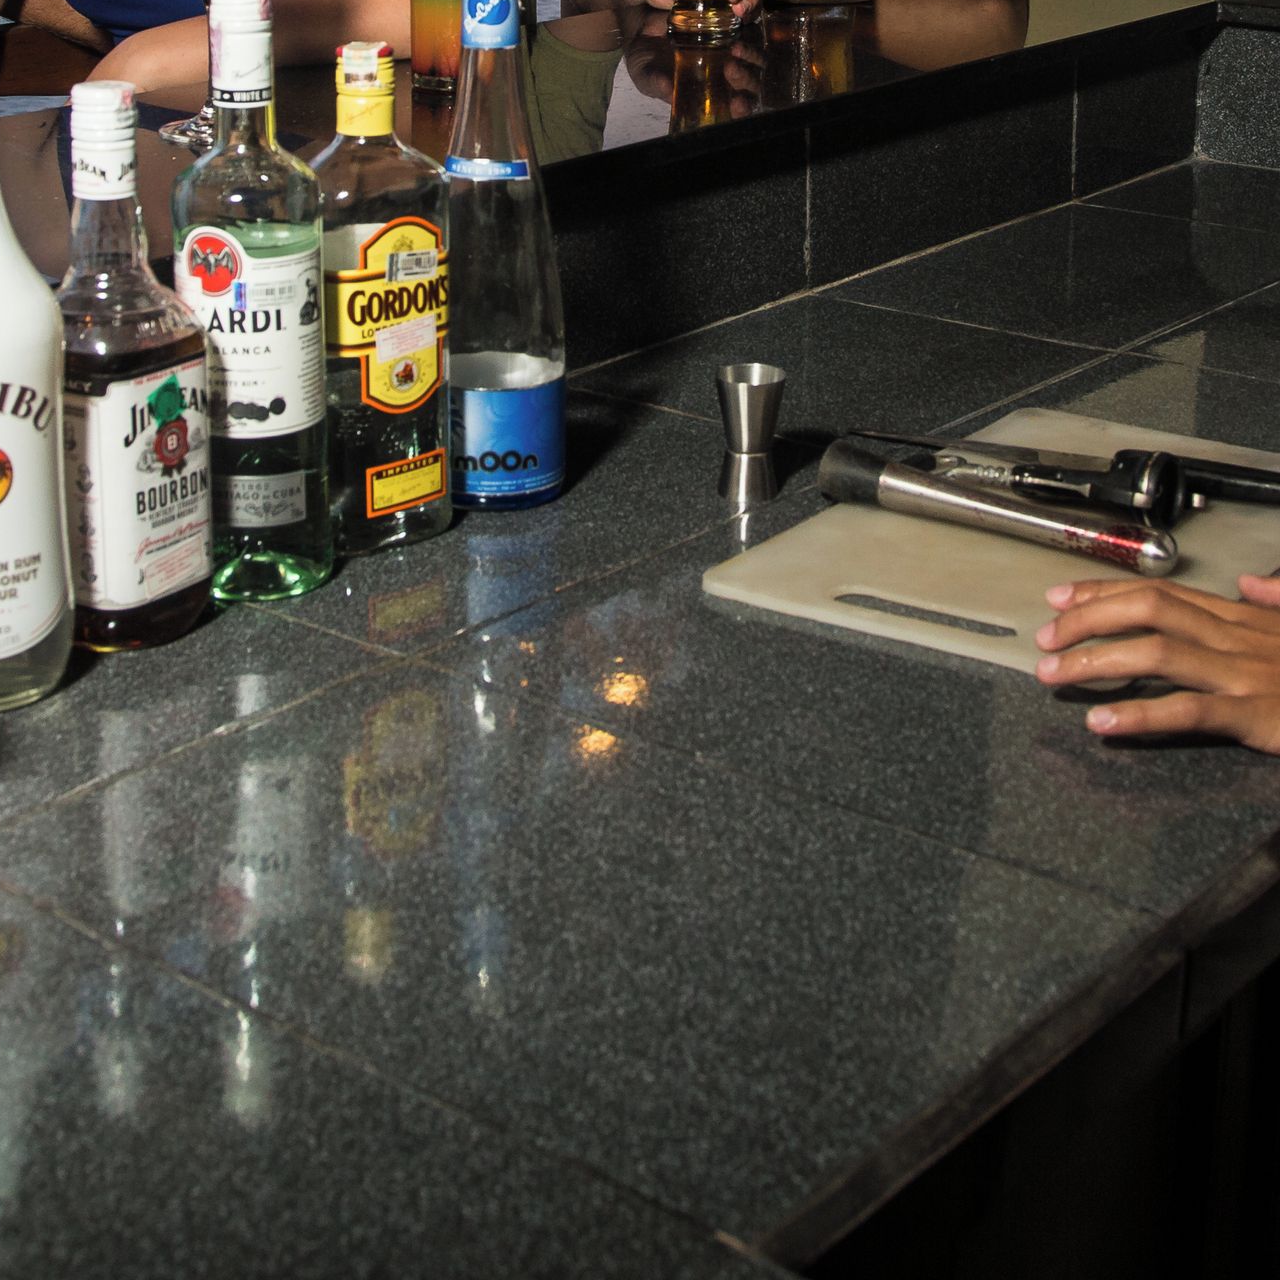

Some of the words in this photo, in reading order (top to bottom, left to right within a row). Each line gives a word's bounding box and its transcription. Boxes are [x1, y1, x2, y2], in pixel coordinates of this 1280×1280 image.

[207, 307, 282, 333] ARDI
[136, 468, 208, 515] BOURBON
[14, 552, 41, 569] RUM
